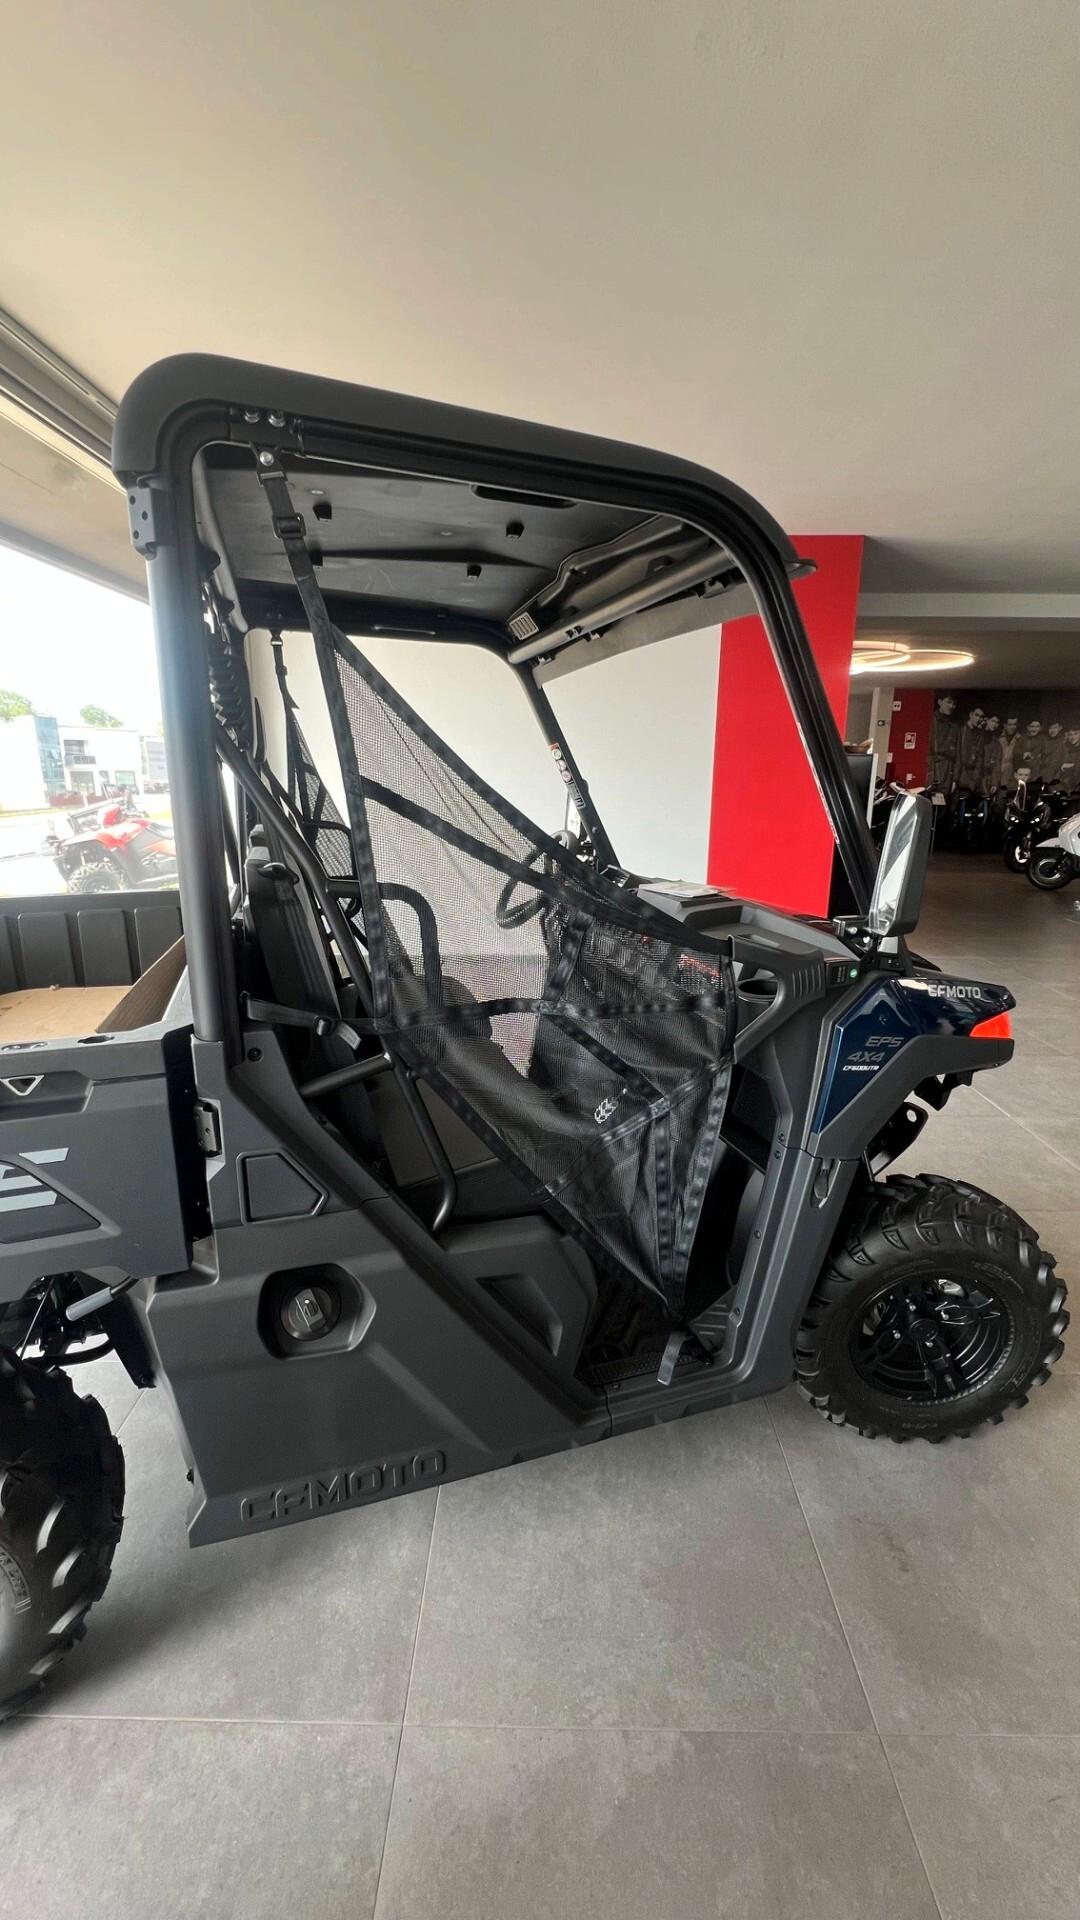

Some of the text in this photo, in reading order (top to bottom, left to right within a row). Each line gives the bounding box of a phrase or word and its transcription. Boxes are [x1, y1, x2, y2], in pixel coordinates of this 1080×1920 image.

[865, 1036, 904, 1047] EPS
[847, 1051, 885, 1062] 4X4
[240, 1450, 447, 1521] CFMOTO
